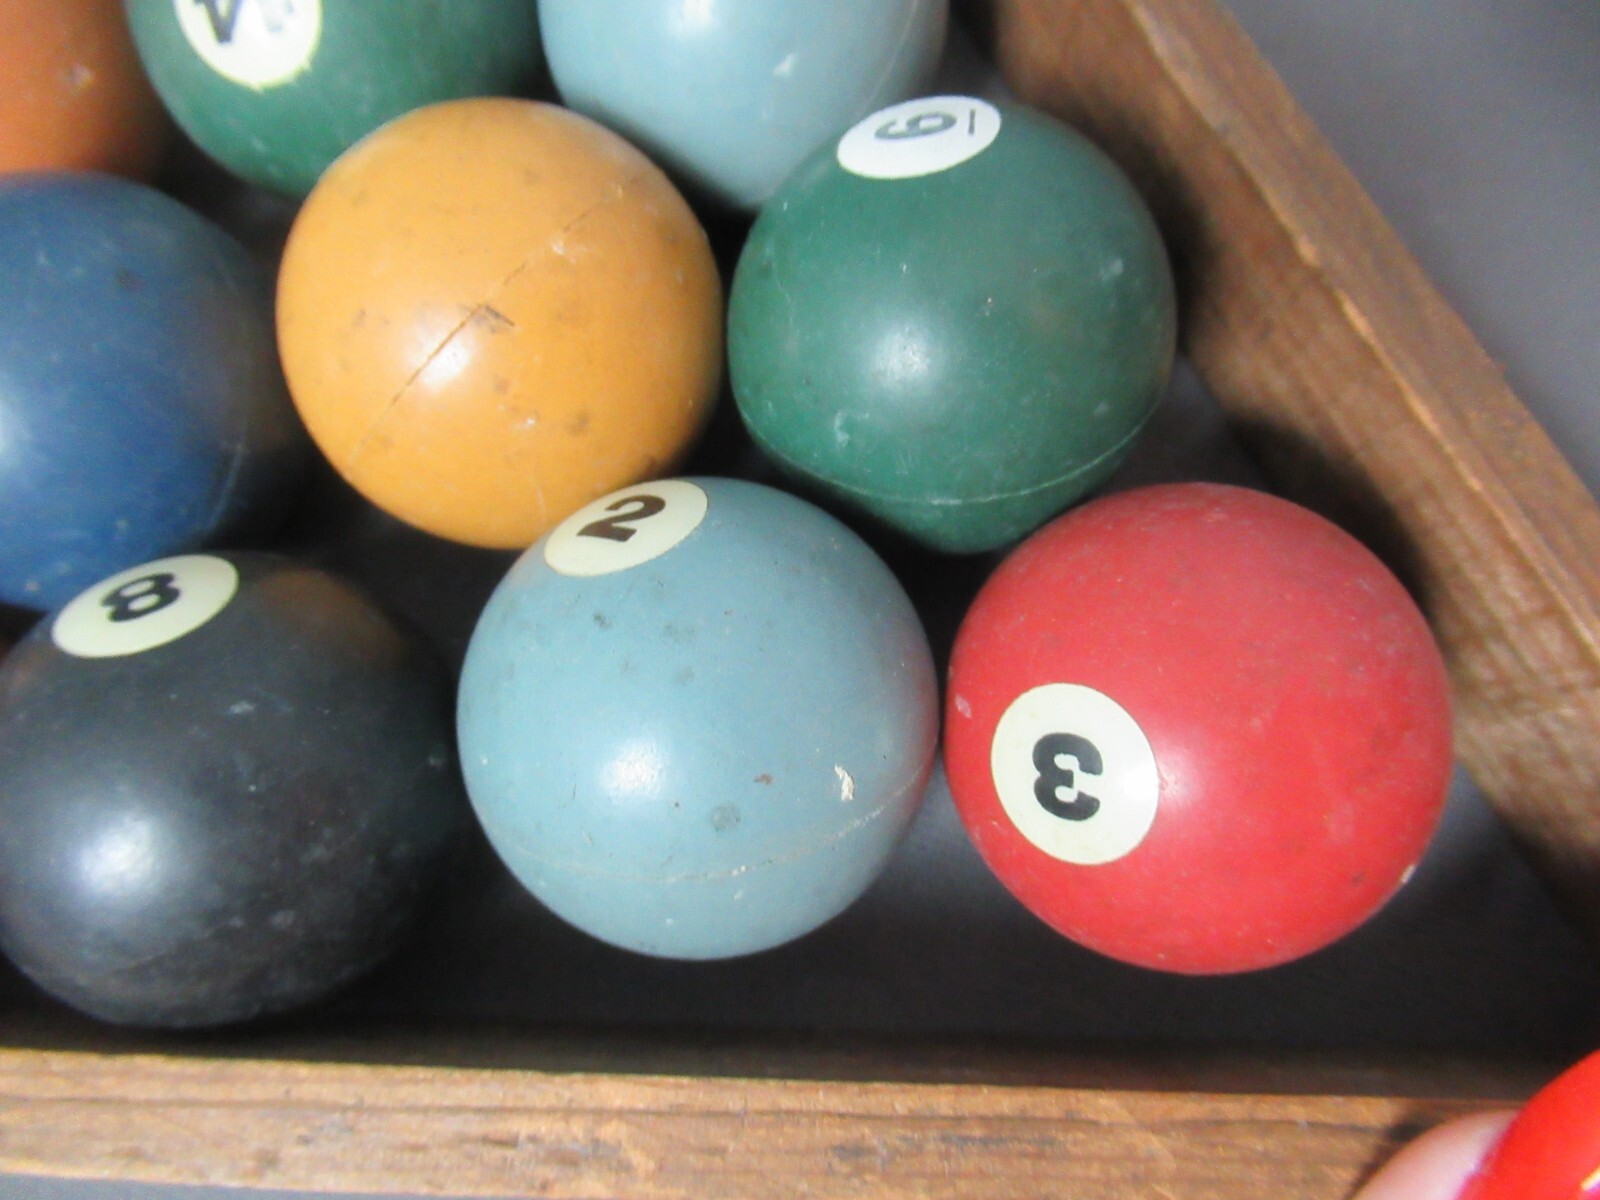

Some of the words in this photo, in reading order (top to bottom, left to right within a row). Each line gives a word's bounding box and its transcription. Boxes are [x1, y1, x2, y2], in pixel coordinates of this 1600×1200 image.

[873, 110, 958, 140] 6
[576, 494, 666, 542] 2
[101, 572, 181, 623] 8
[1032, 732, 1103, 821] 3
